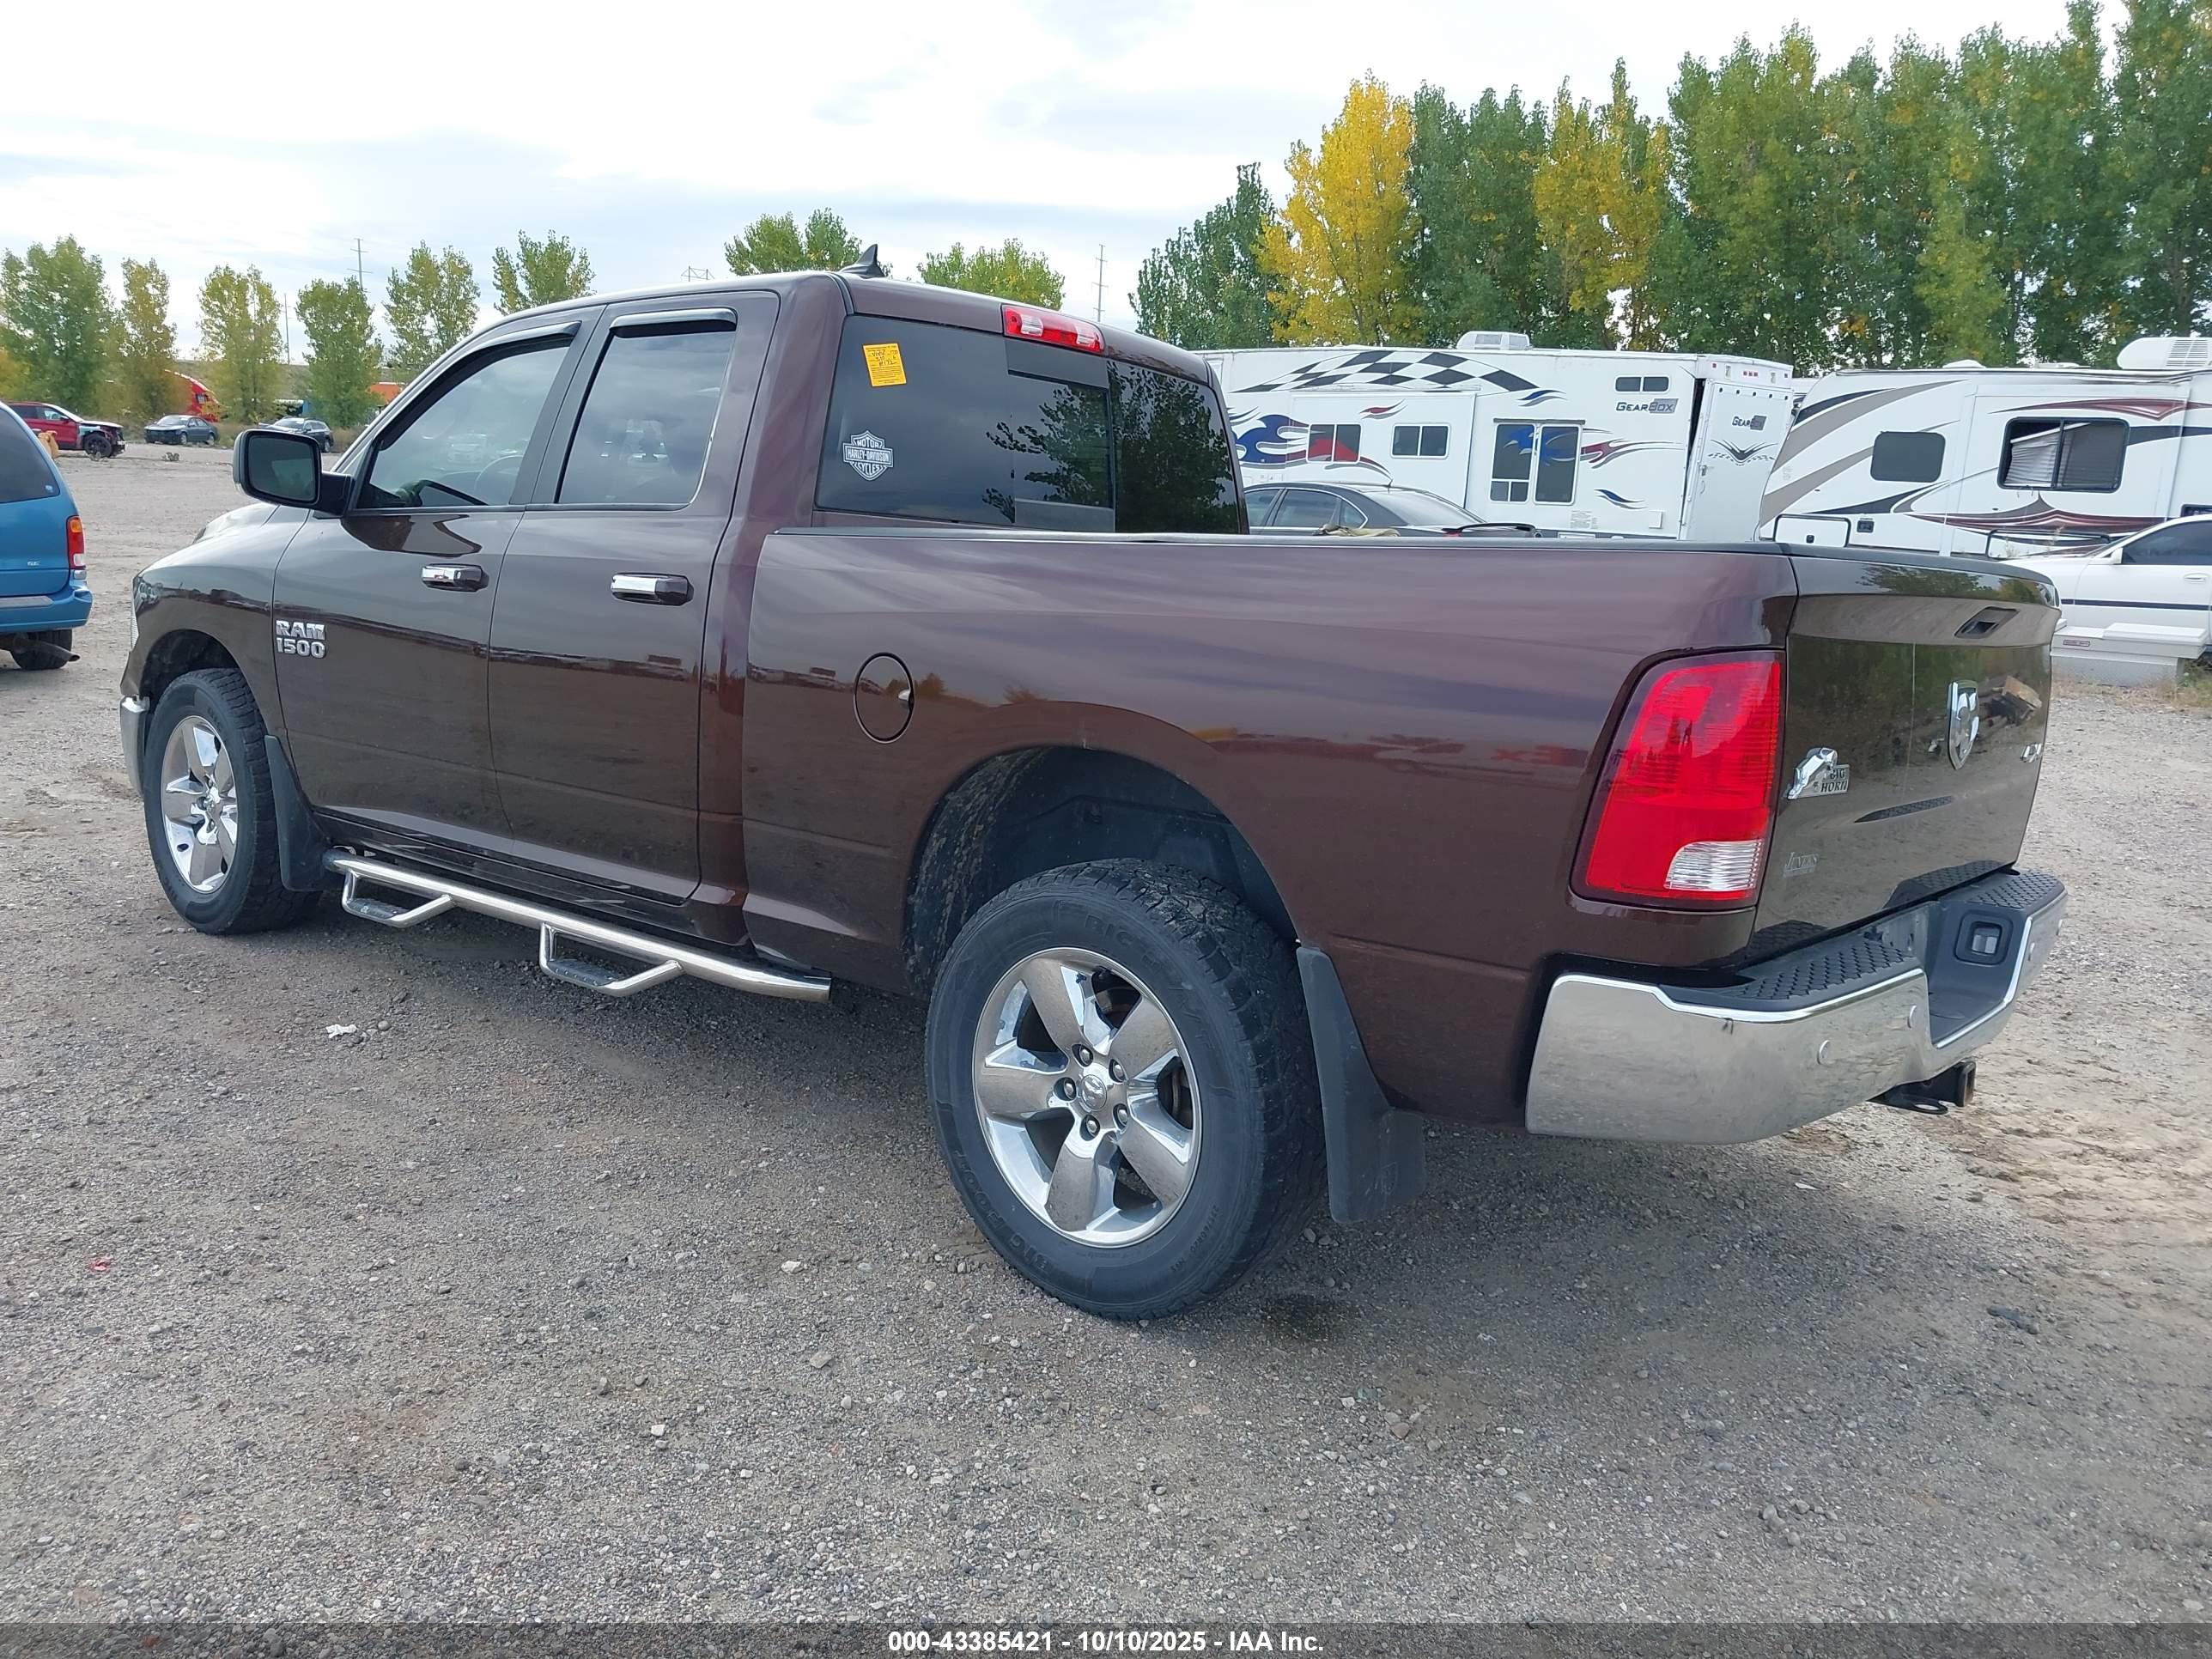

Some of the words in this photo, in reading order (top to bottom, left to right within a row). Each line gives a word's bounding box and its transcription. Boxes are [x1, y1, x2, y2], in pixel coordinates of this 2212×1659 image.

[856, 436, 879, 448] MOTOR
[847, 448, 890, 463] HARLEY-DAVIDSON
[857, 462, 880, 476] CYCLES
[276, 620, 325, 641] RAM
[276, 637, 325, 659] 1500
[1829, 768, 1846, 780] BIG
[1820, 780, 1848, 793] HORN
[953, 1150, 1005, 1231] FOOT
[1008, 1231, 1054, 1273] BIG
